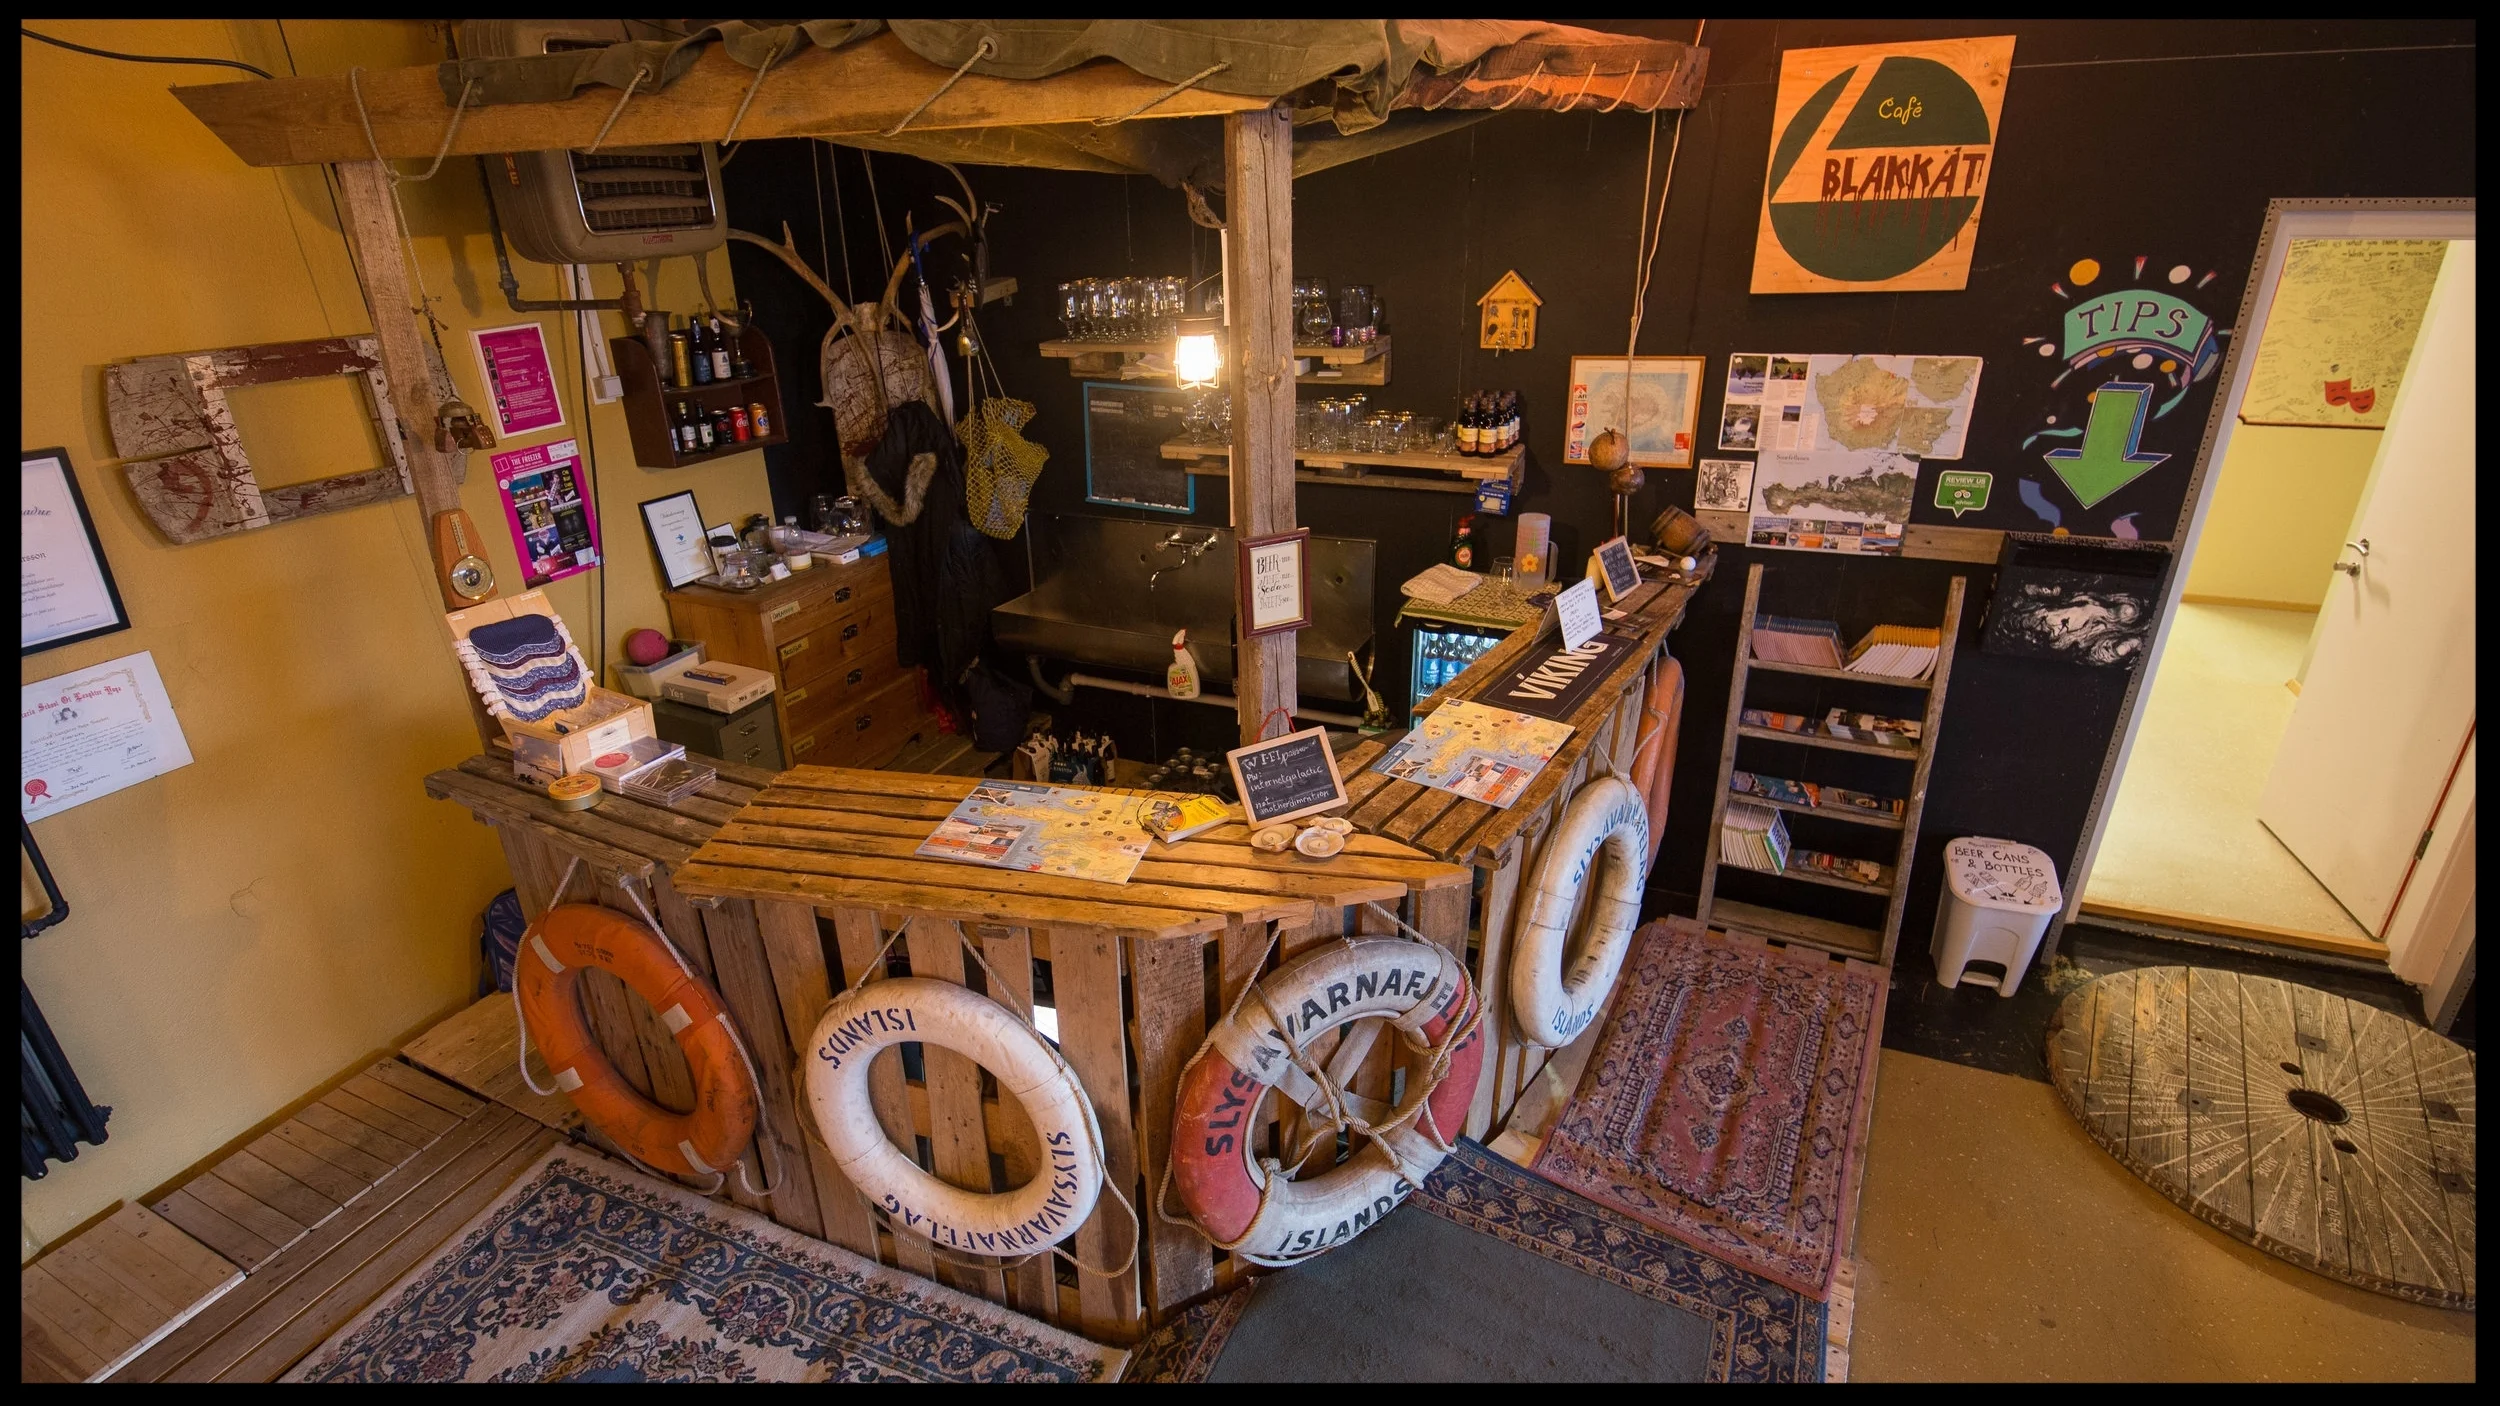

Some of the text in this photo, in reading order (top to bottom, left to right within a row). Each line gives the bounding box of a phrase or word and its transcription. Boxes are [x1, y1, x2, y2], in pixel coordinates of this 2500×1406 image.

[1878, 96, 1923, 125] Café
[1821, 147, 1987, 201] BLAKKÁT
[2077, 301, 2189, 340] TIPS
[511, 452, 543, 466] THE FREEZER
[1945, 476, 1974, 484] REVIEW
[1256, 554, 1280, 575] BEER
[1171, 675, 1188, 687] AJAX
[1508, 640, 1609, 700] VÍKING
[668, 687, 684, 698] Yes
[1250, 765, 1324, 793] internetgalactic
[1954, 846, 2030, 864] BEER CANS
[1968, 858, 2045, 878] & BOTTLES
[1551, 1003, 1594, 1037] ISLANDS
[818, 1008, 916, 1070] ISLANDS
[1277, 1178, 1415, 1252] ISLANDS
